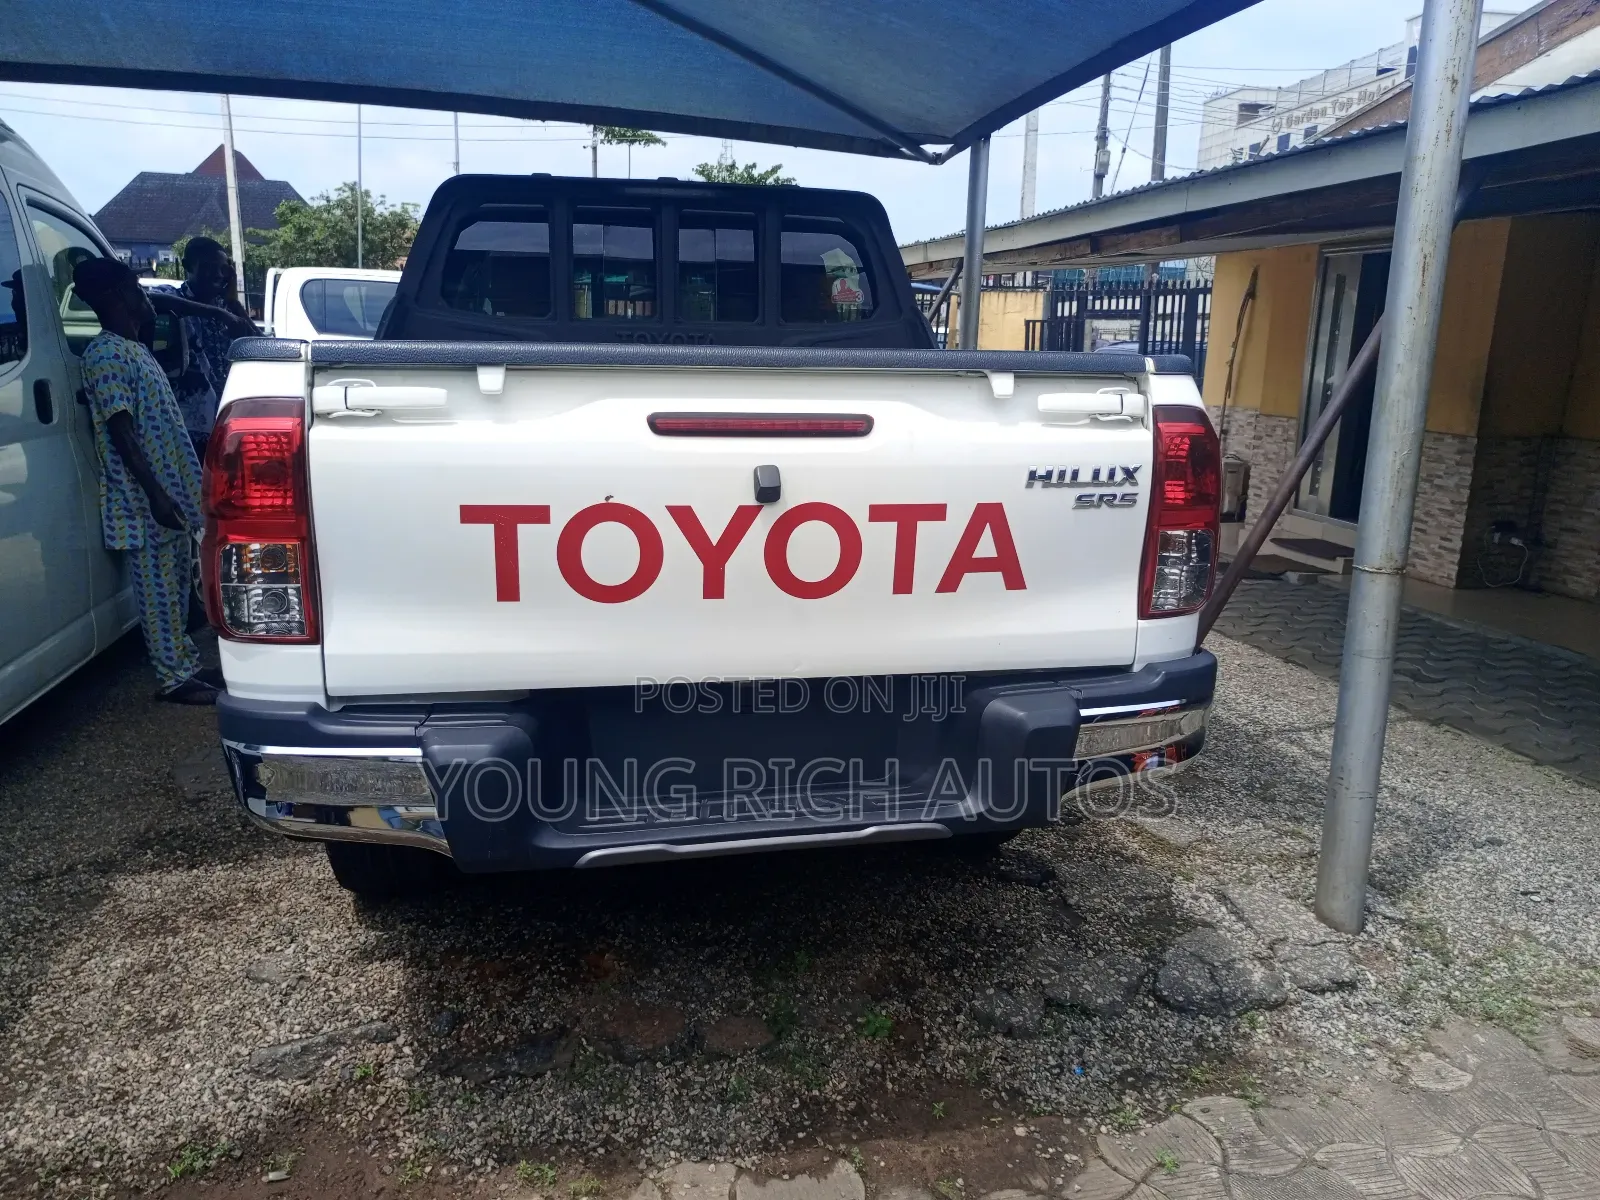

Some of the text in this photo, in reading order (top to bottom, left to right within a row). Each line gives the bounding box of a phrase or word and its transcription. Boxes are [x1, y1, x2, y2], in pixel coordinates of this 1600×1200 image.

[1286, 106, 1327, 128] Garden
[1331, 98, 1353, 115] Top
[1025, 464, 1142, 488] HILUX
[1072, 492, 1139, 509] SR5
[459, 501, 1028, 604] TOYOTA
